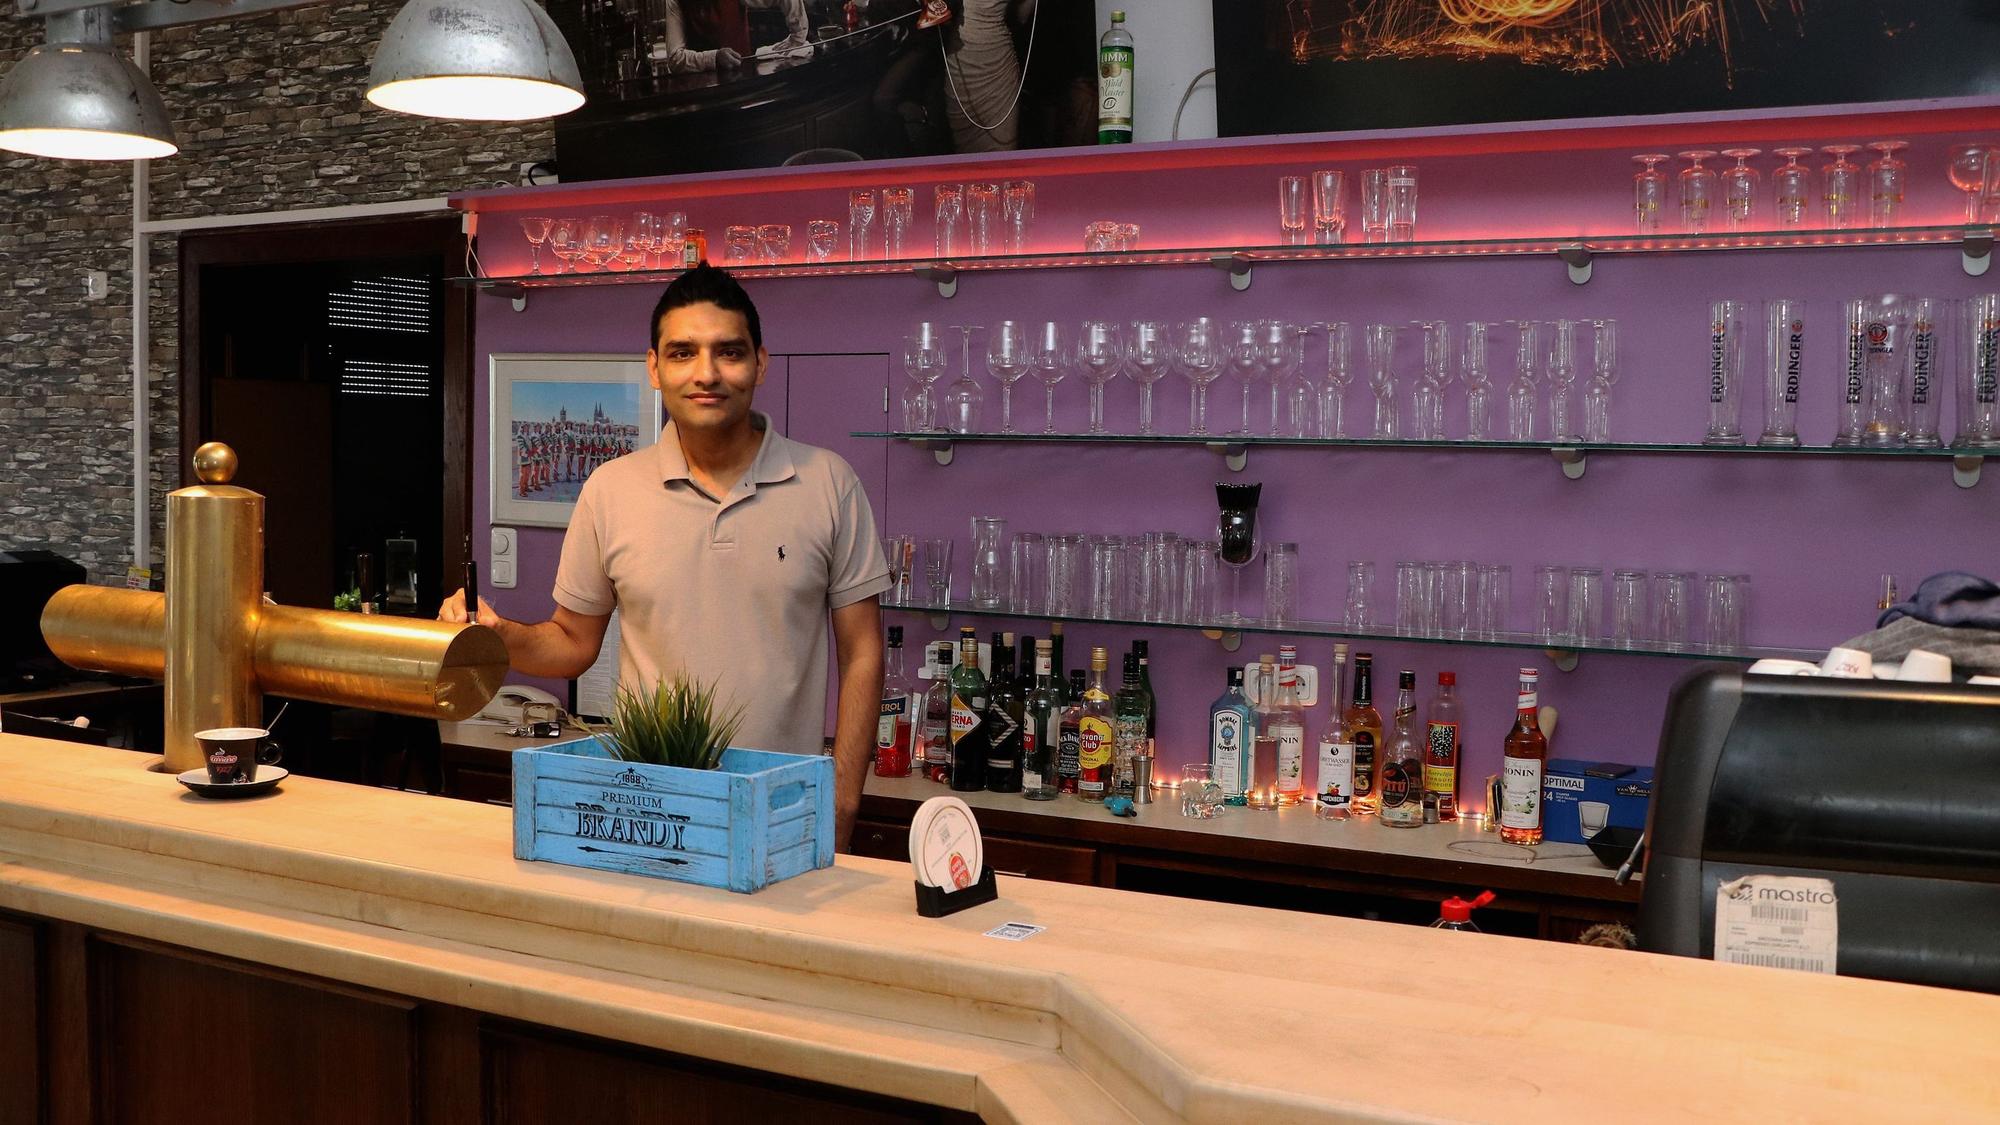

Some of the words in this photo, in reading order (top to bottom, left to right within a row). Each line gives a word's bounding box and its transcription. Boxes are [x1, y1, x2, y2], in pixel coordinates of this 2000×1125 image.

[1785, 333, 1803, 404] ERDINGER
[1846, 333, 1865, 404] ERDINGER
[1912, 331, 1933, 404] ERDINGER
[1082, 740, 1097, 749] Club
[602, 791, 663, 809] PREMIUM
[575, 803, 690, 850] BRANDY
[1760, 888, 1834, 904] mastro
